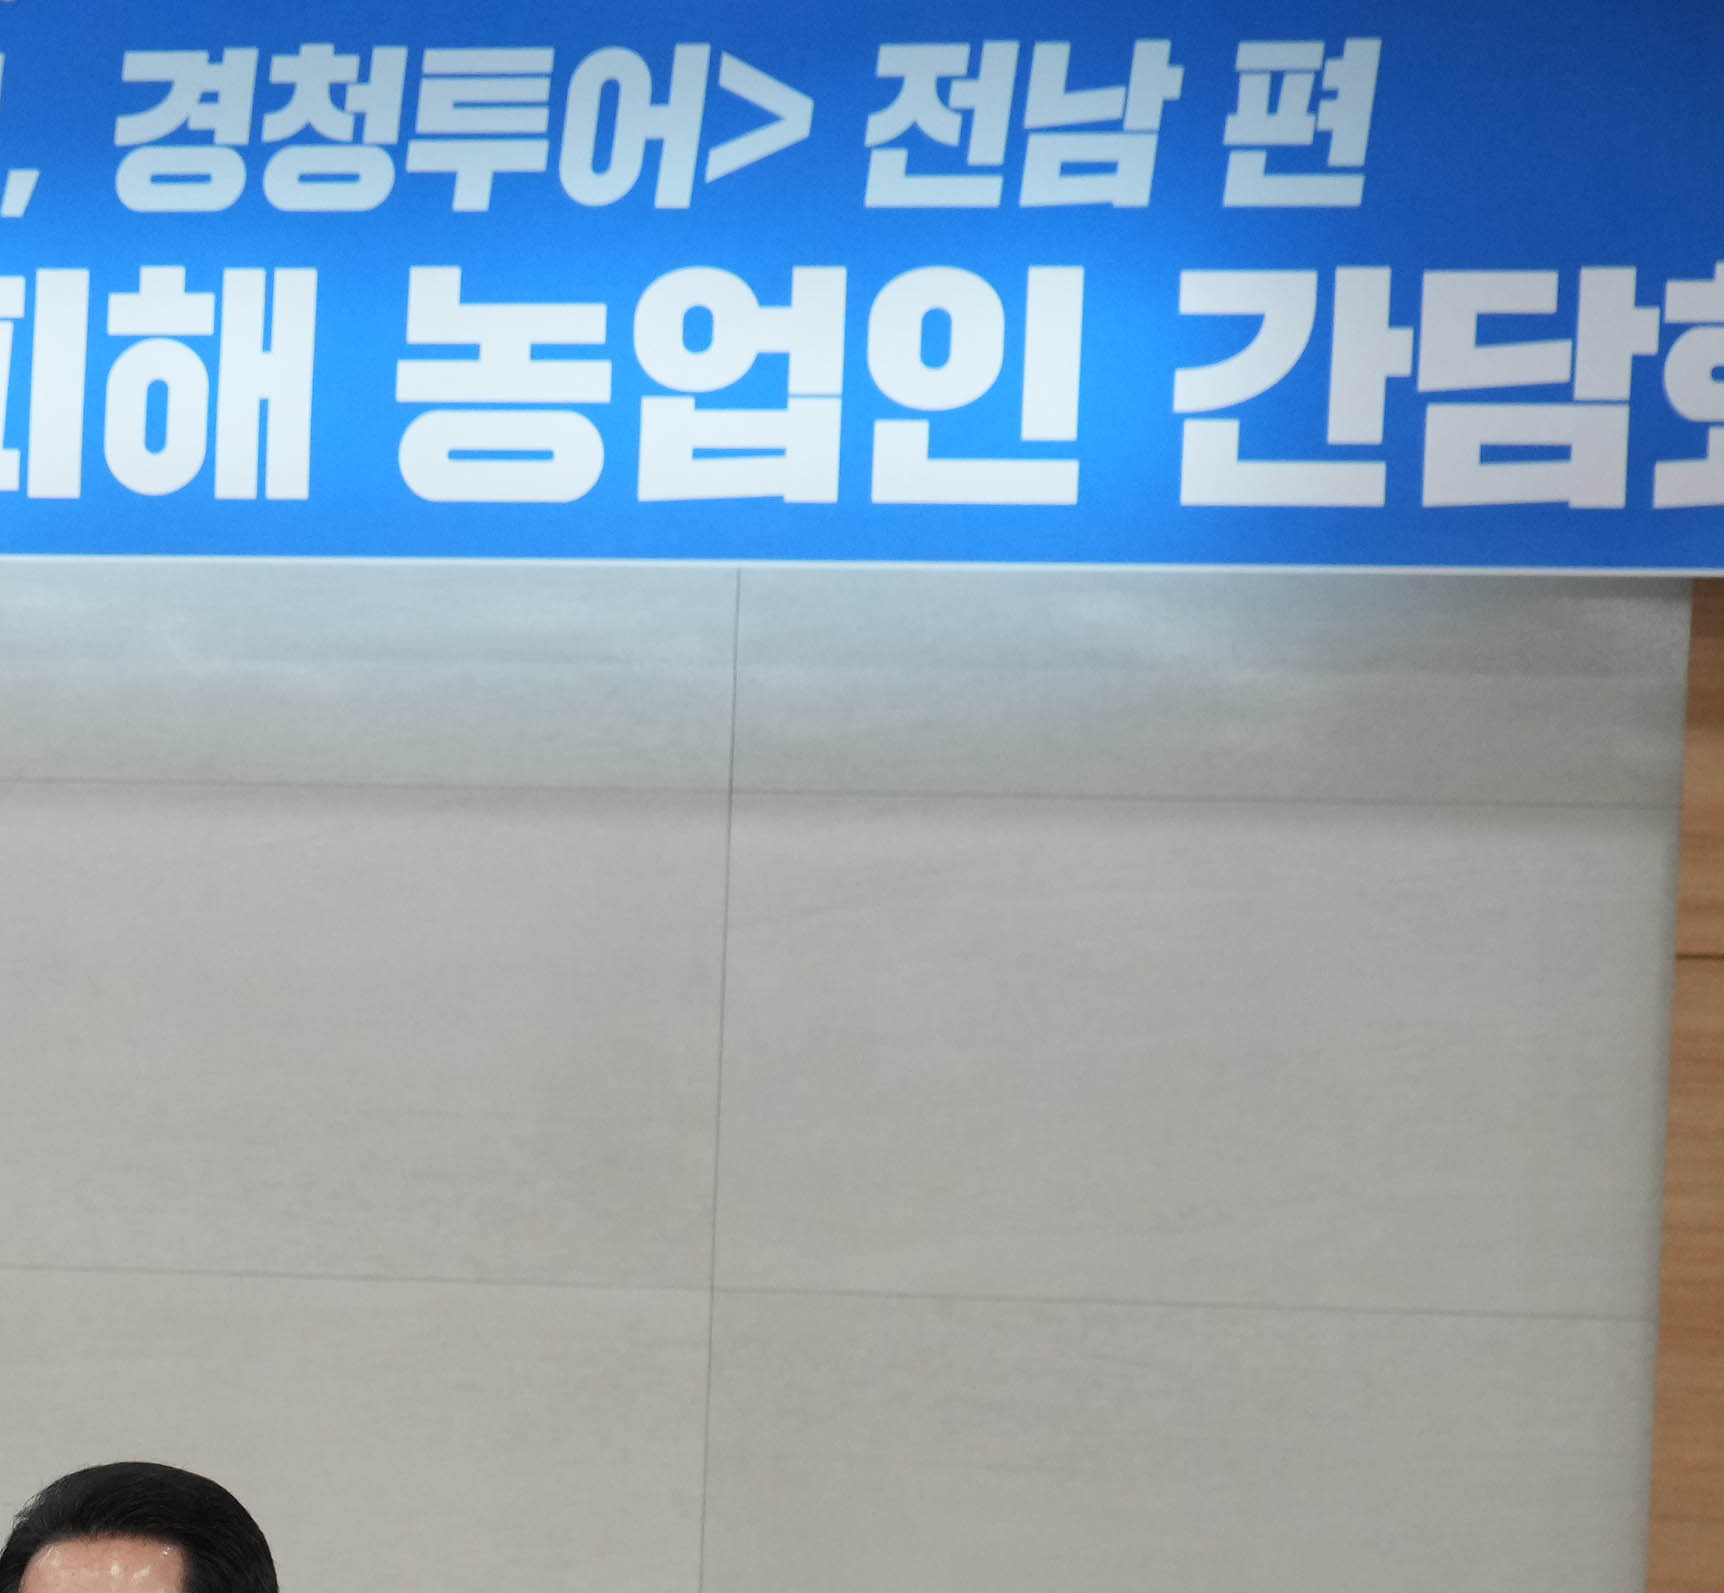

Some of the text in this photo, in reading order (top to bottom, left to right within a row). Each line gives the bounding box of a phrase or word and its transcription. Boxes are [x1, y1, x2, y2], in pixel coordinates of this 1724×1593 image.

[114, 44, 814, 213] 경청투어>
[864, 41, 1184, 208] 전남
[1223, 38, 1381, 207] 편
[394, 265, 1085, 506] 농업인
